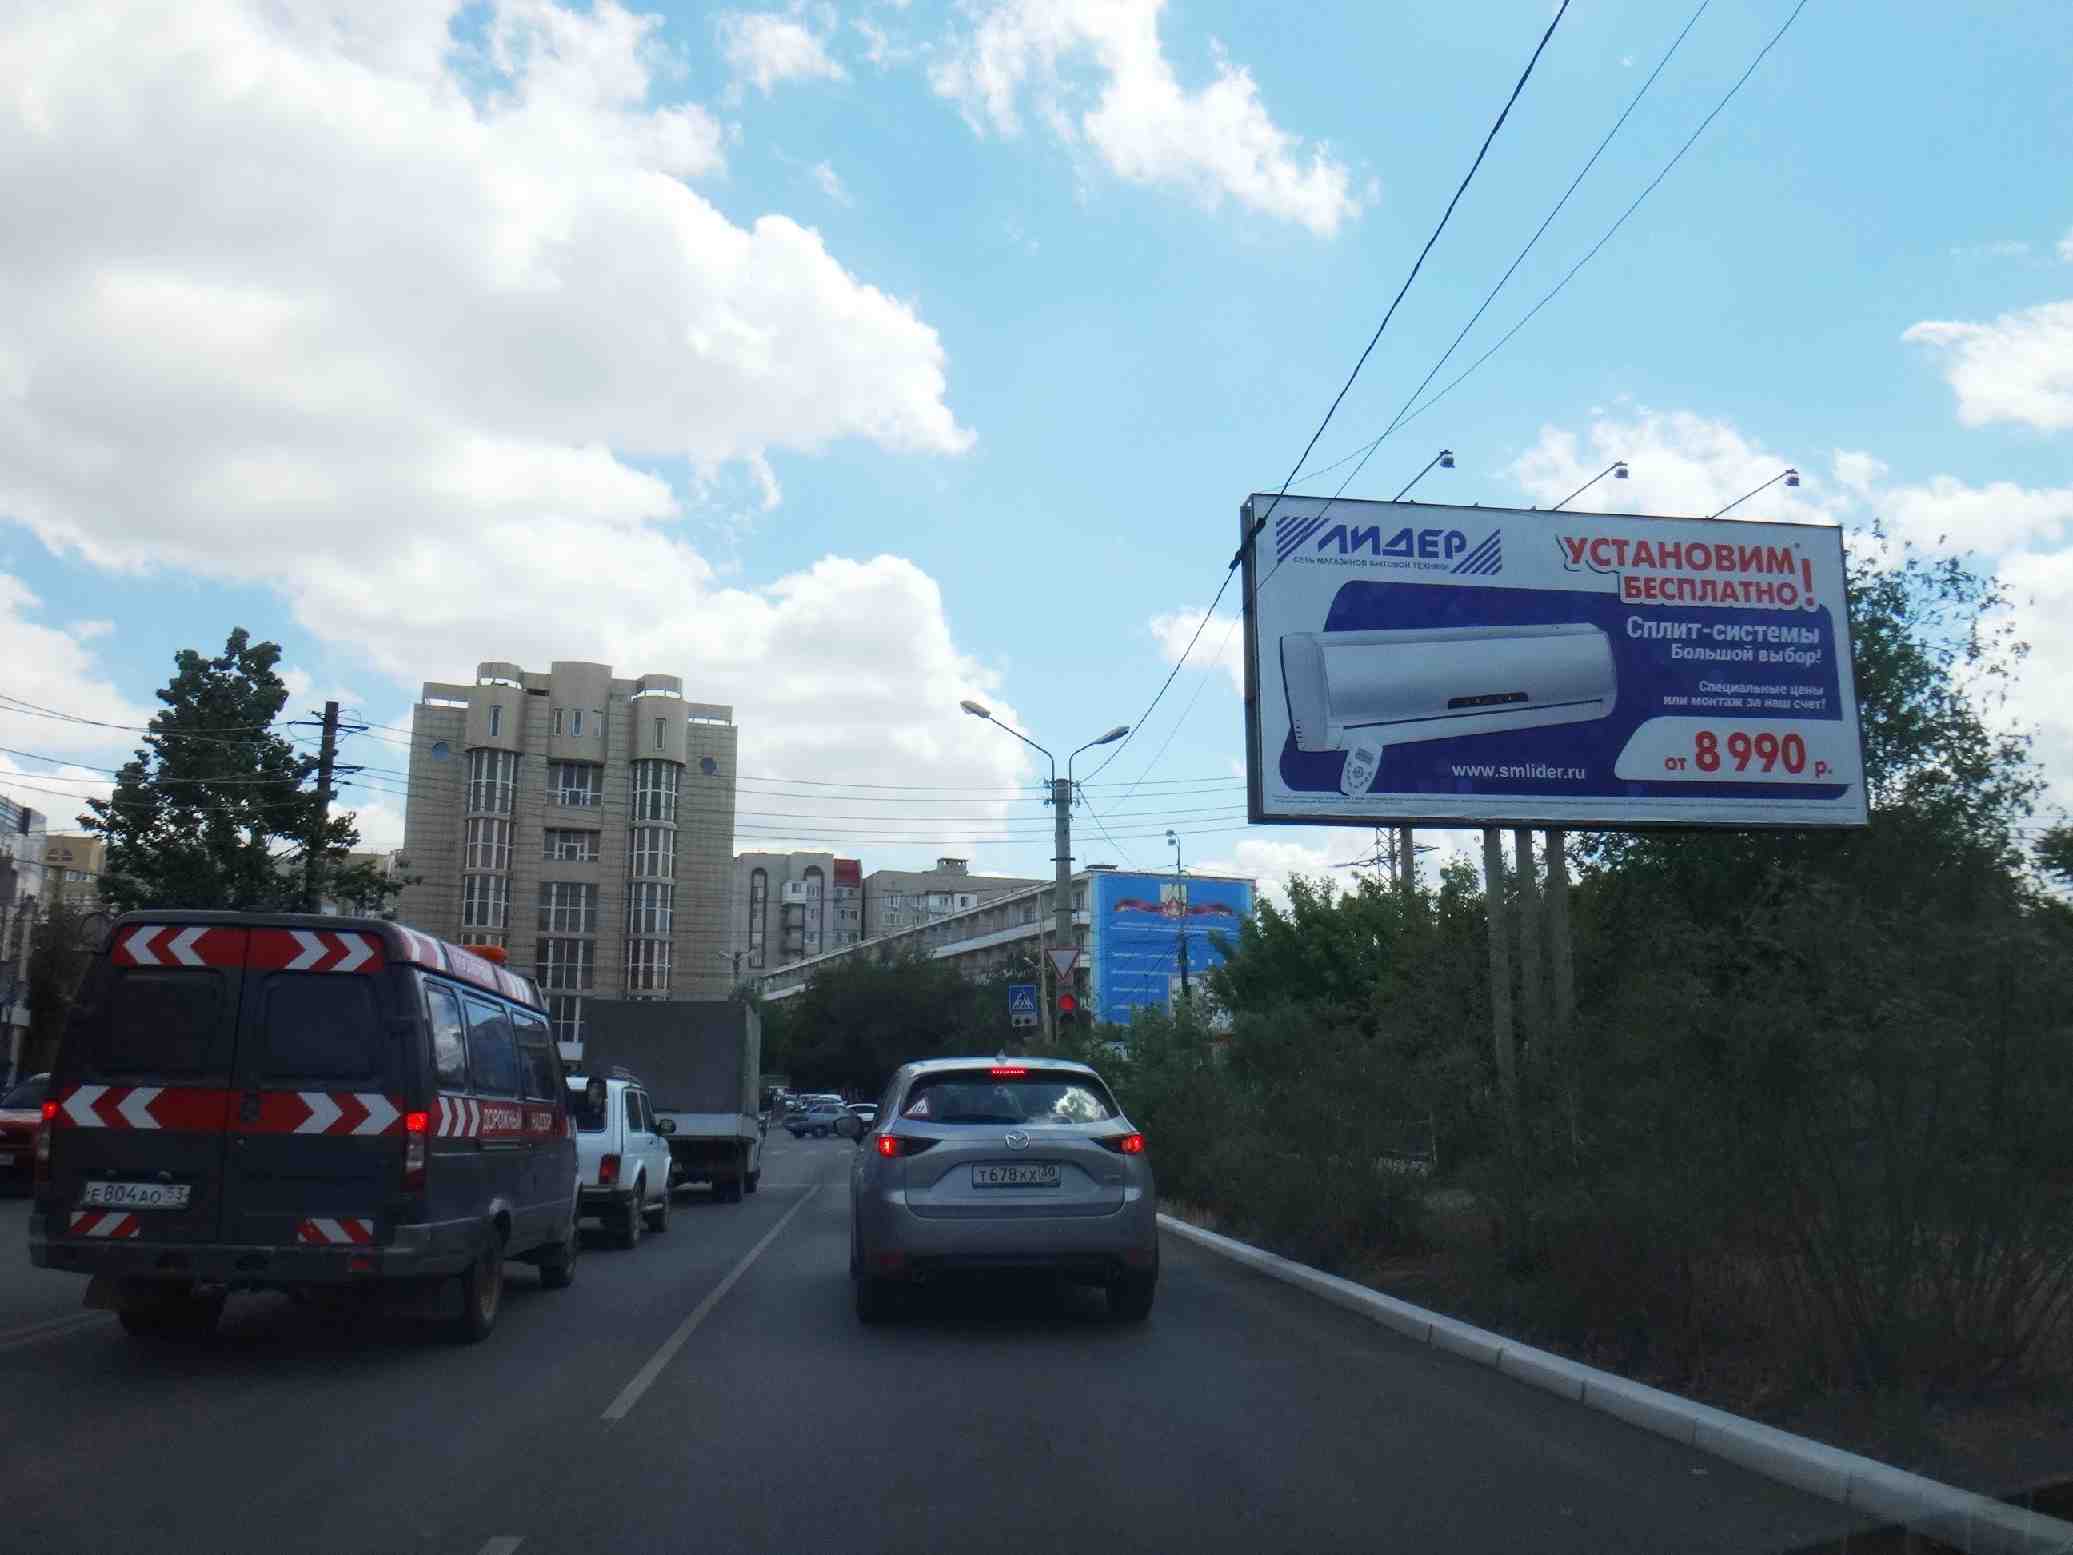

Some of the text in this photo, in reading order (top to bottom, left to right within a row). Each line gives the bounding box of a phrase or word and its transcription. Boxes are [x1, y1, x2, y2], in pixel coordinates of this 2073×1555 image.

[1318, 525, 1467, 559] ЛИДЕР
[1626, 616, 1820, 643] Сплит-системы
[1671, 644, 1822, 667] Большой выбор!
[1699, 680, 1824, 697] Специальные цены
[1663, 696, 1688, 706] или
[1691, 697, 1744, 707] монтаж
[1747, 699, 1761, 708] за
[1765, 699, 1791, 709] наш
[1451, 763, 1586, 780] www.smlider.ru
[1664, 757, 1687, 771] от
